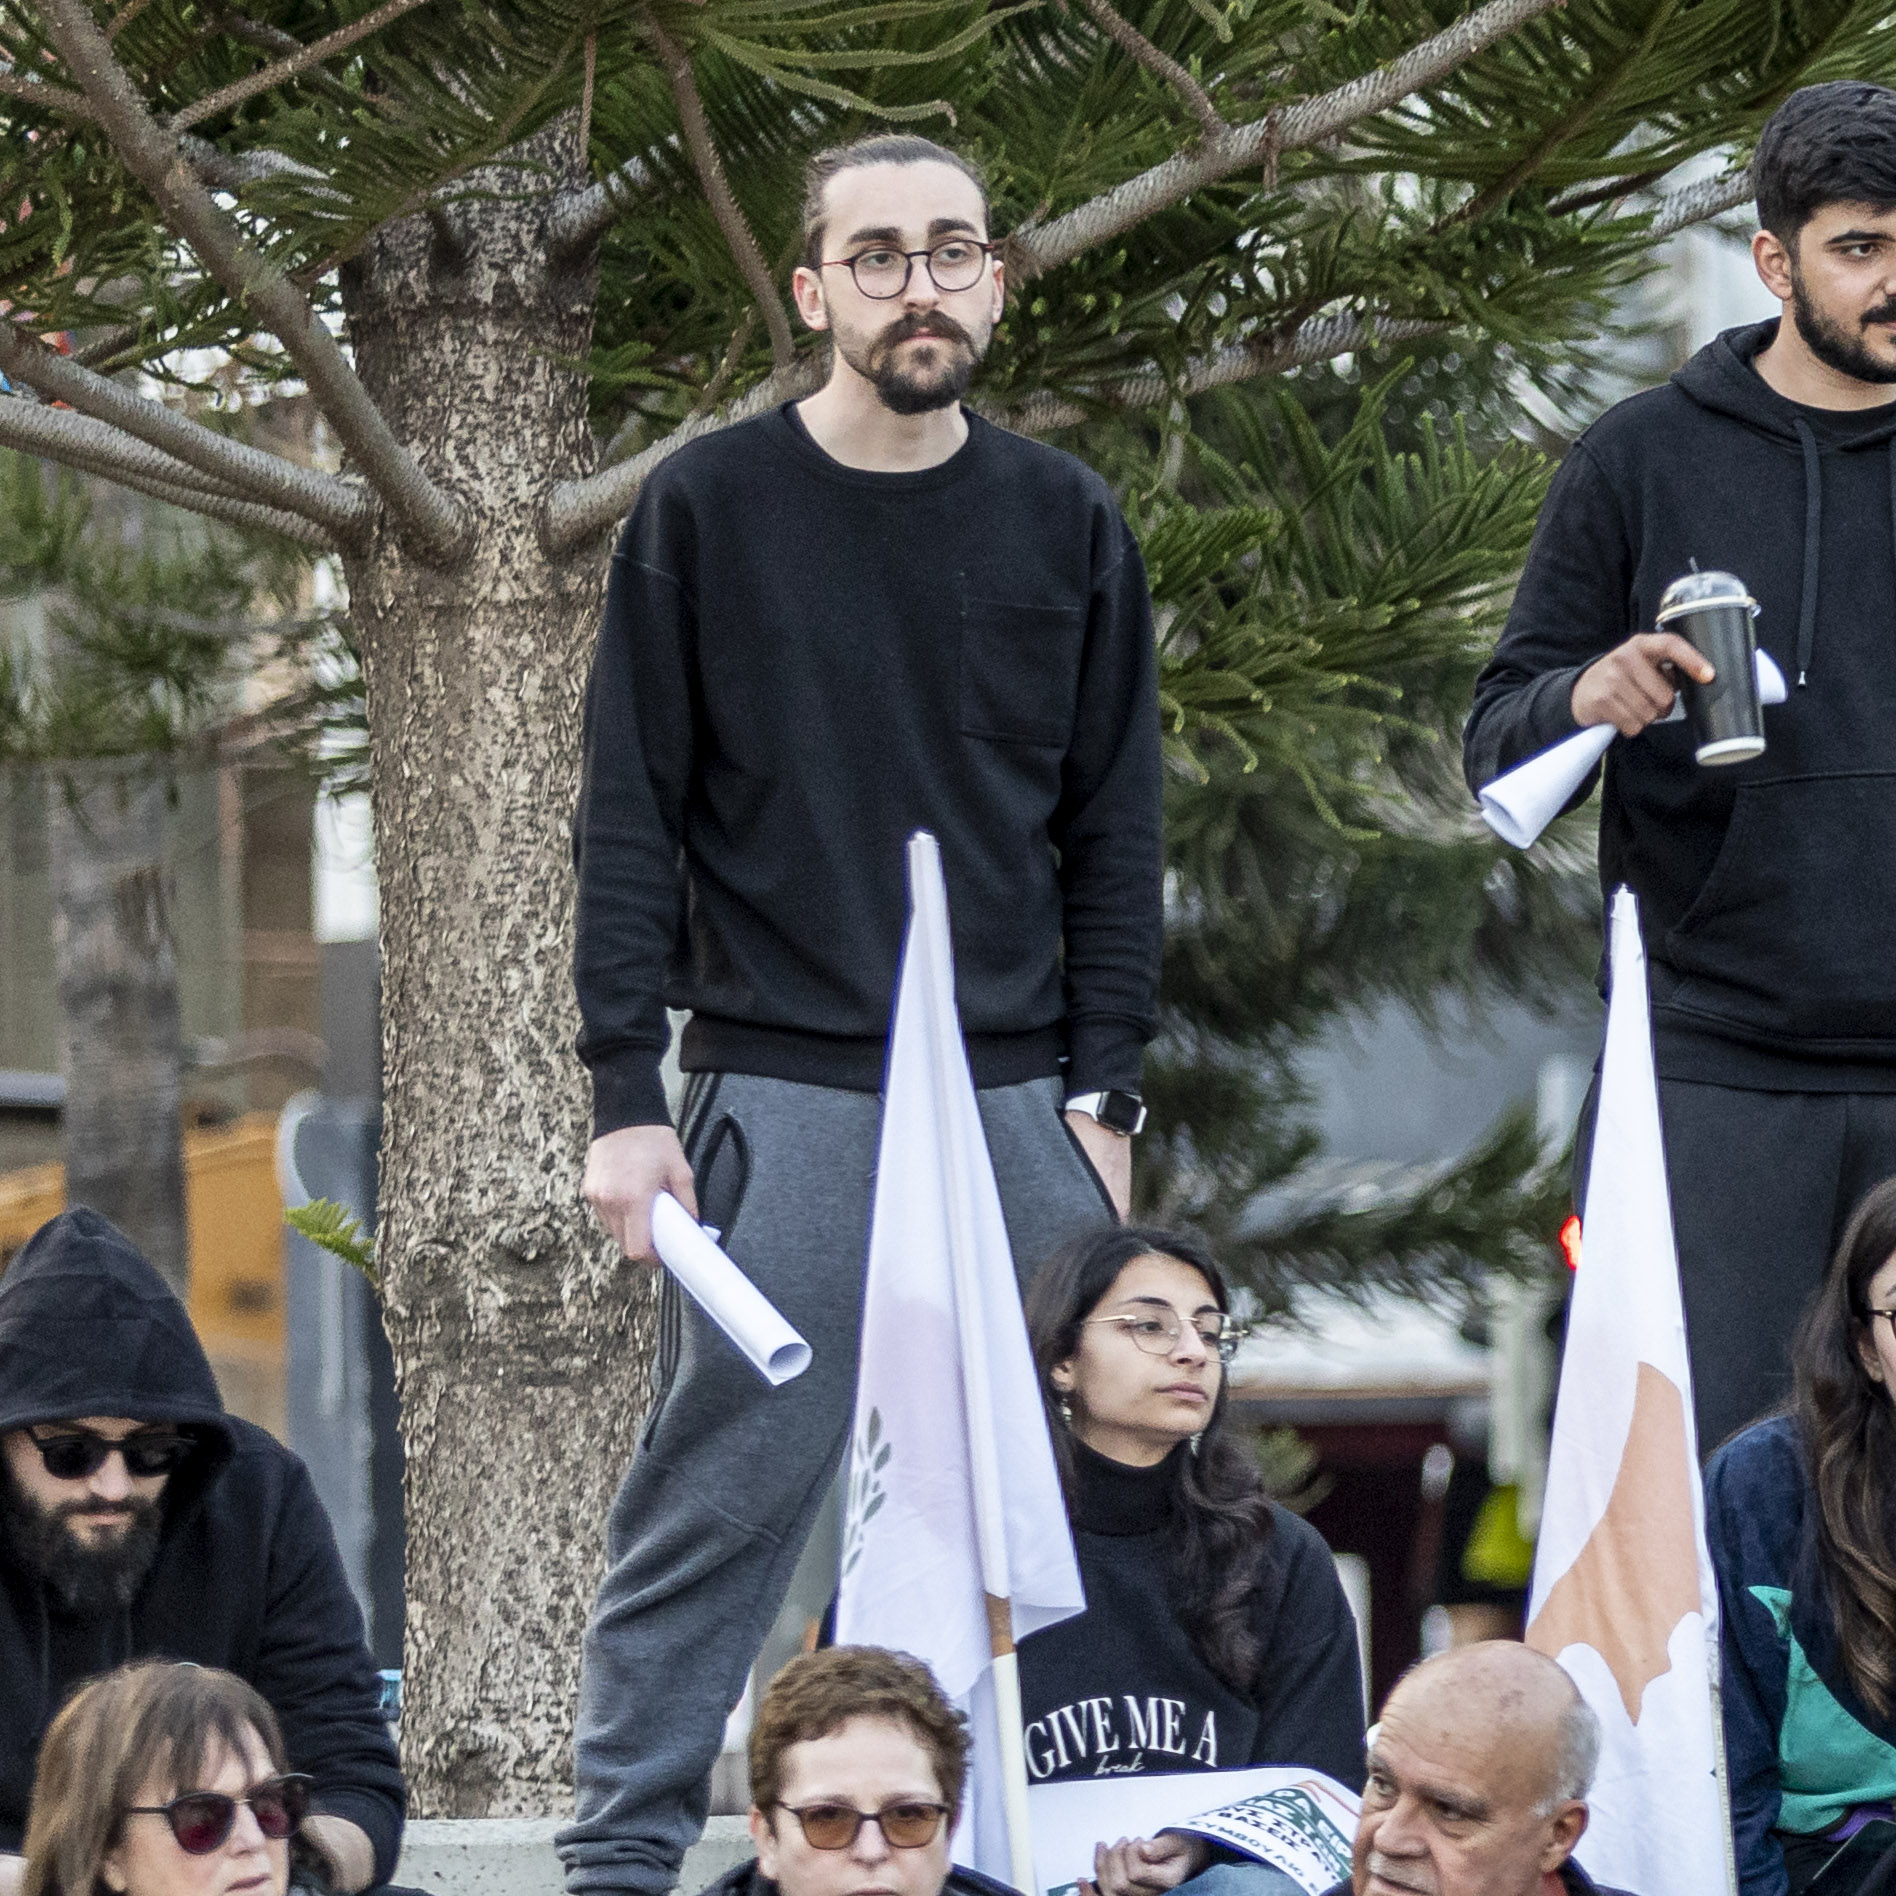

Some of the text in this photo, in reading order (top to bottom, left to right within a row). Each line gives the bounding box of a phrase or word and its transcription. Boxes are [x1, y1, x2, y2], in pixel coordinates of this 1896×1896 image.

[1024, 1695, 1218, 1779] GIVE ME A
